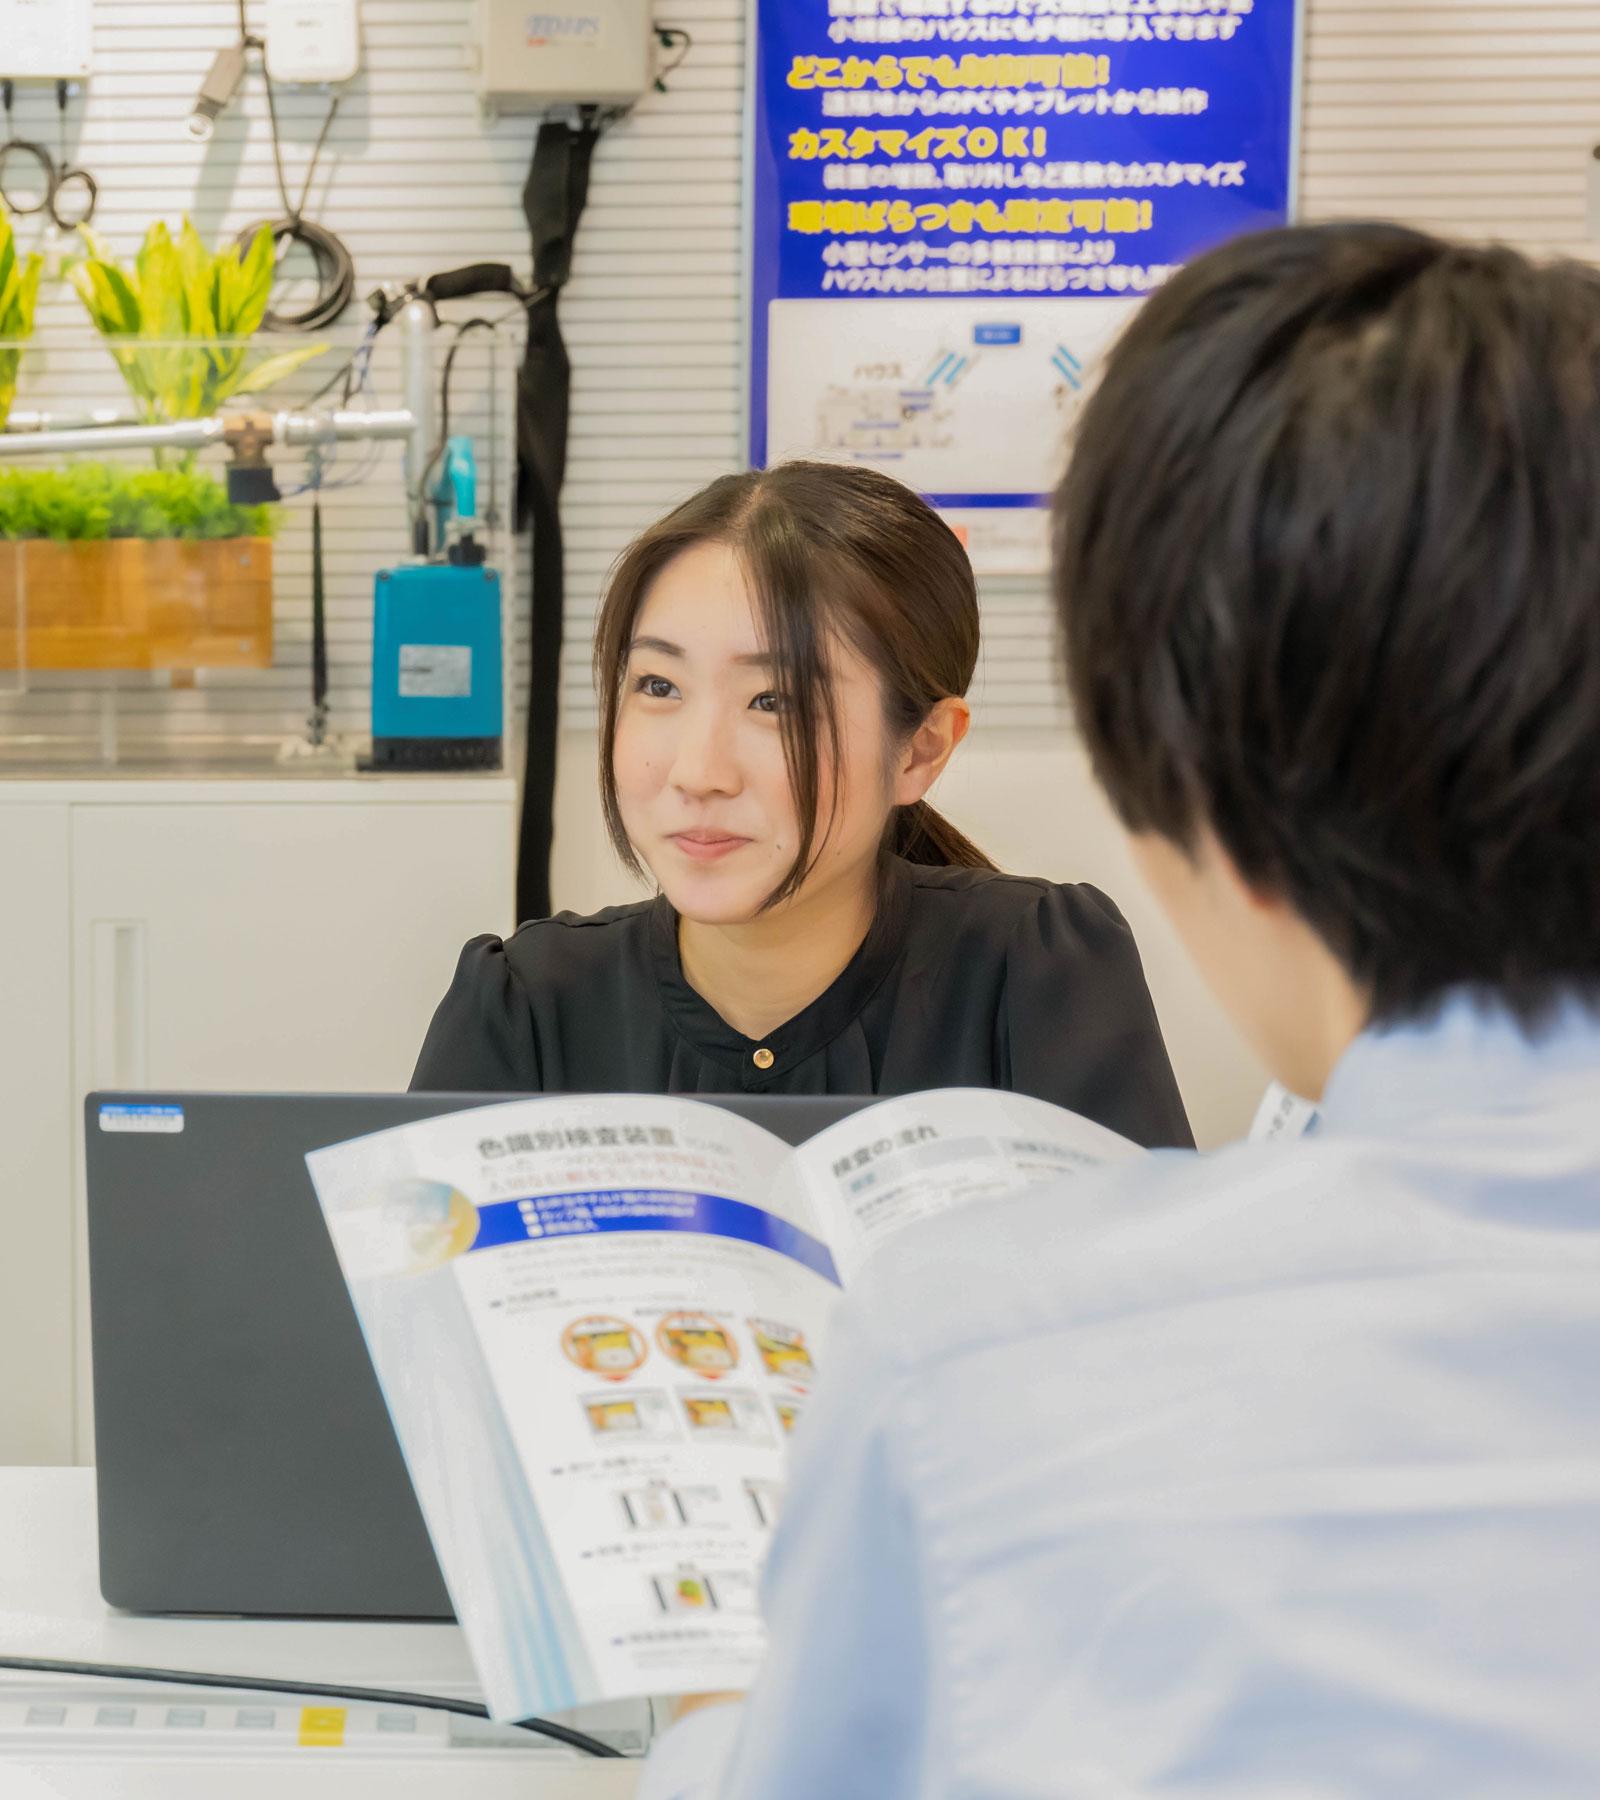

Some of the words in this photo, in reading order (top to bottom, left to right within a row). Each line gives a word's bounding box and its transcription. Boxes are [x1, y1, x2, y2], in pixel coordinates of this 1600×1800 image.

[787, 126, 1048, 161] カスタマイズOK!
